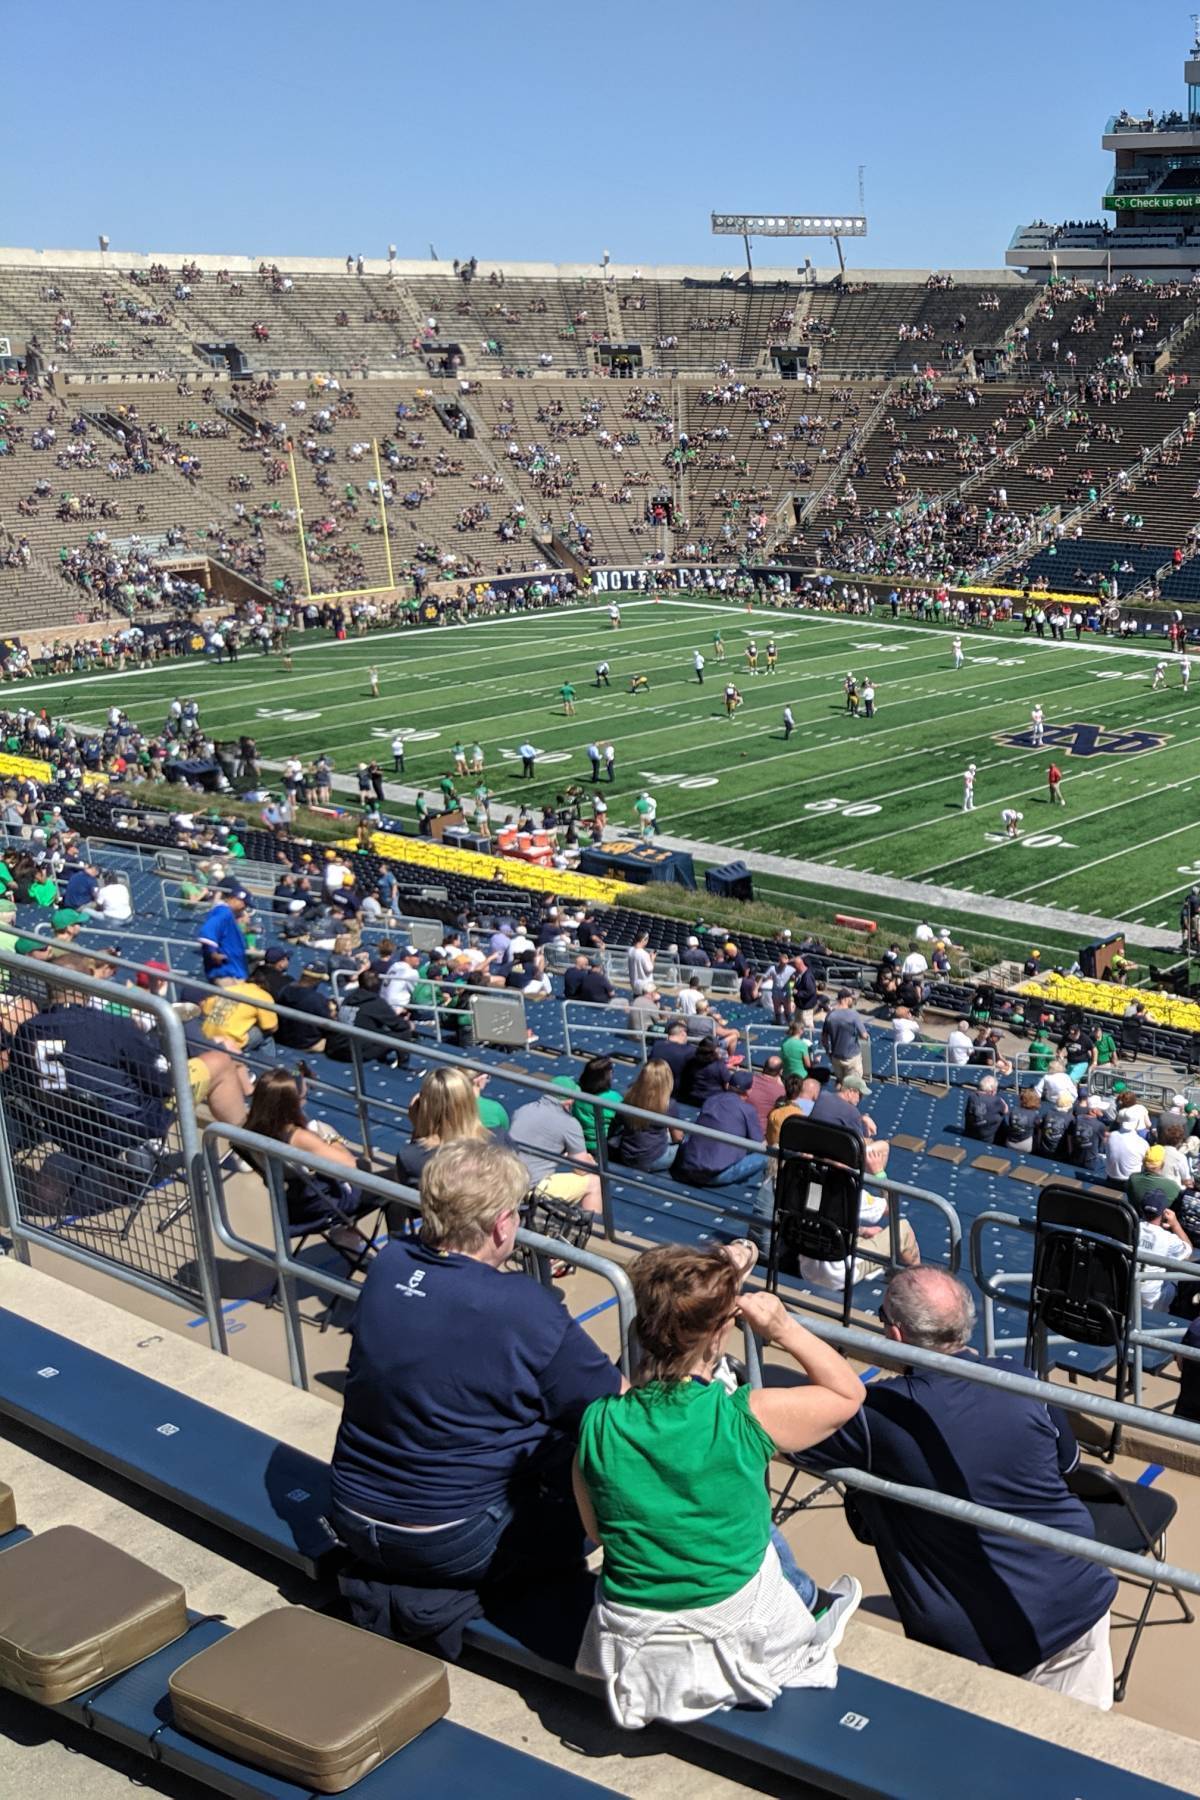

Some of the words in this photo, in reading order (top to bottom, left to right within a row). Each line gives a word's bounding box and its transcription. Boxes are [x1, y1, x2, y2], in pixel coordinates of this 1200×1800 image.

[1129, 198, 1162, 209] Check
[1162, 199, 1174, 207] us
[1176, 198, 1193, 207] out
[803, 798, 882, 816] 50
